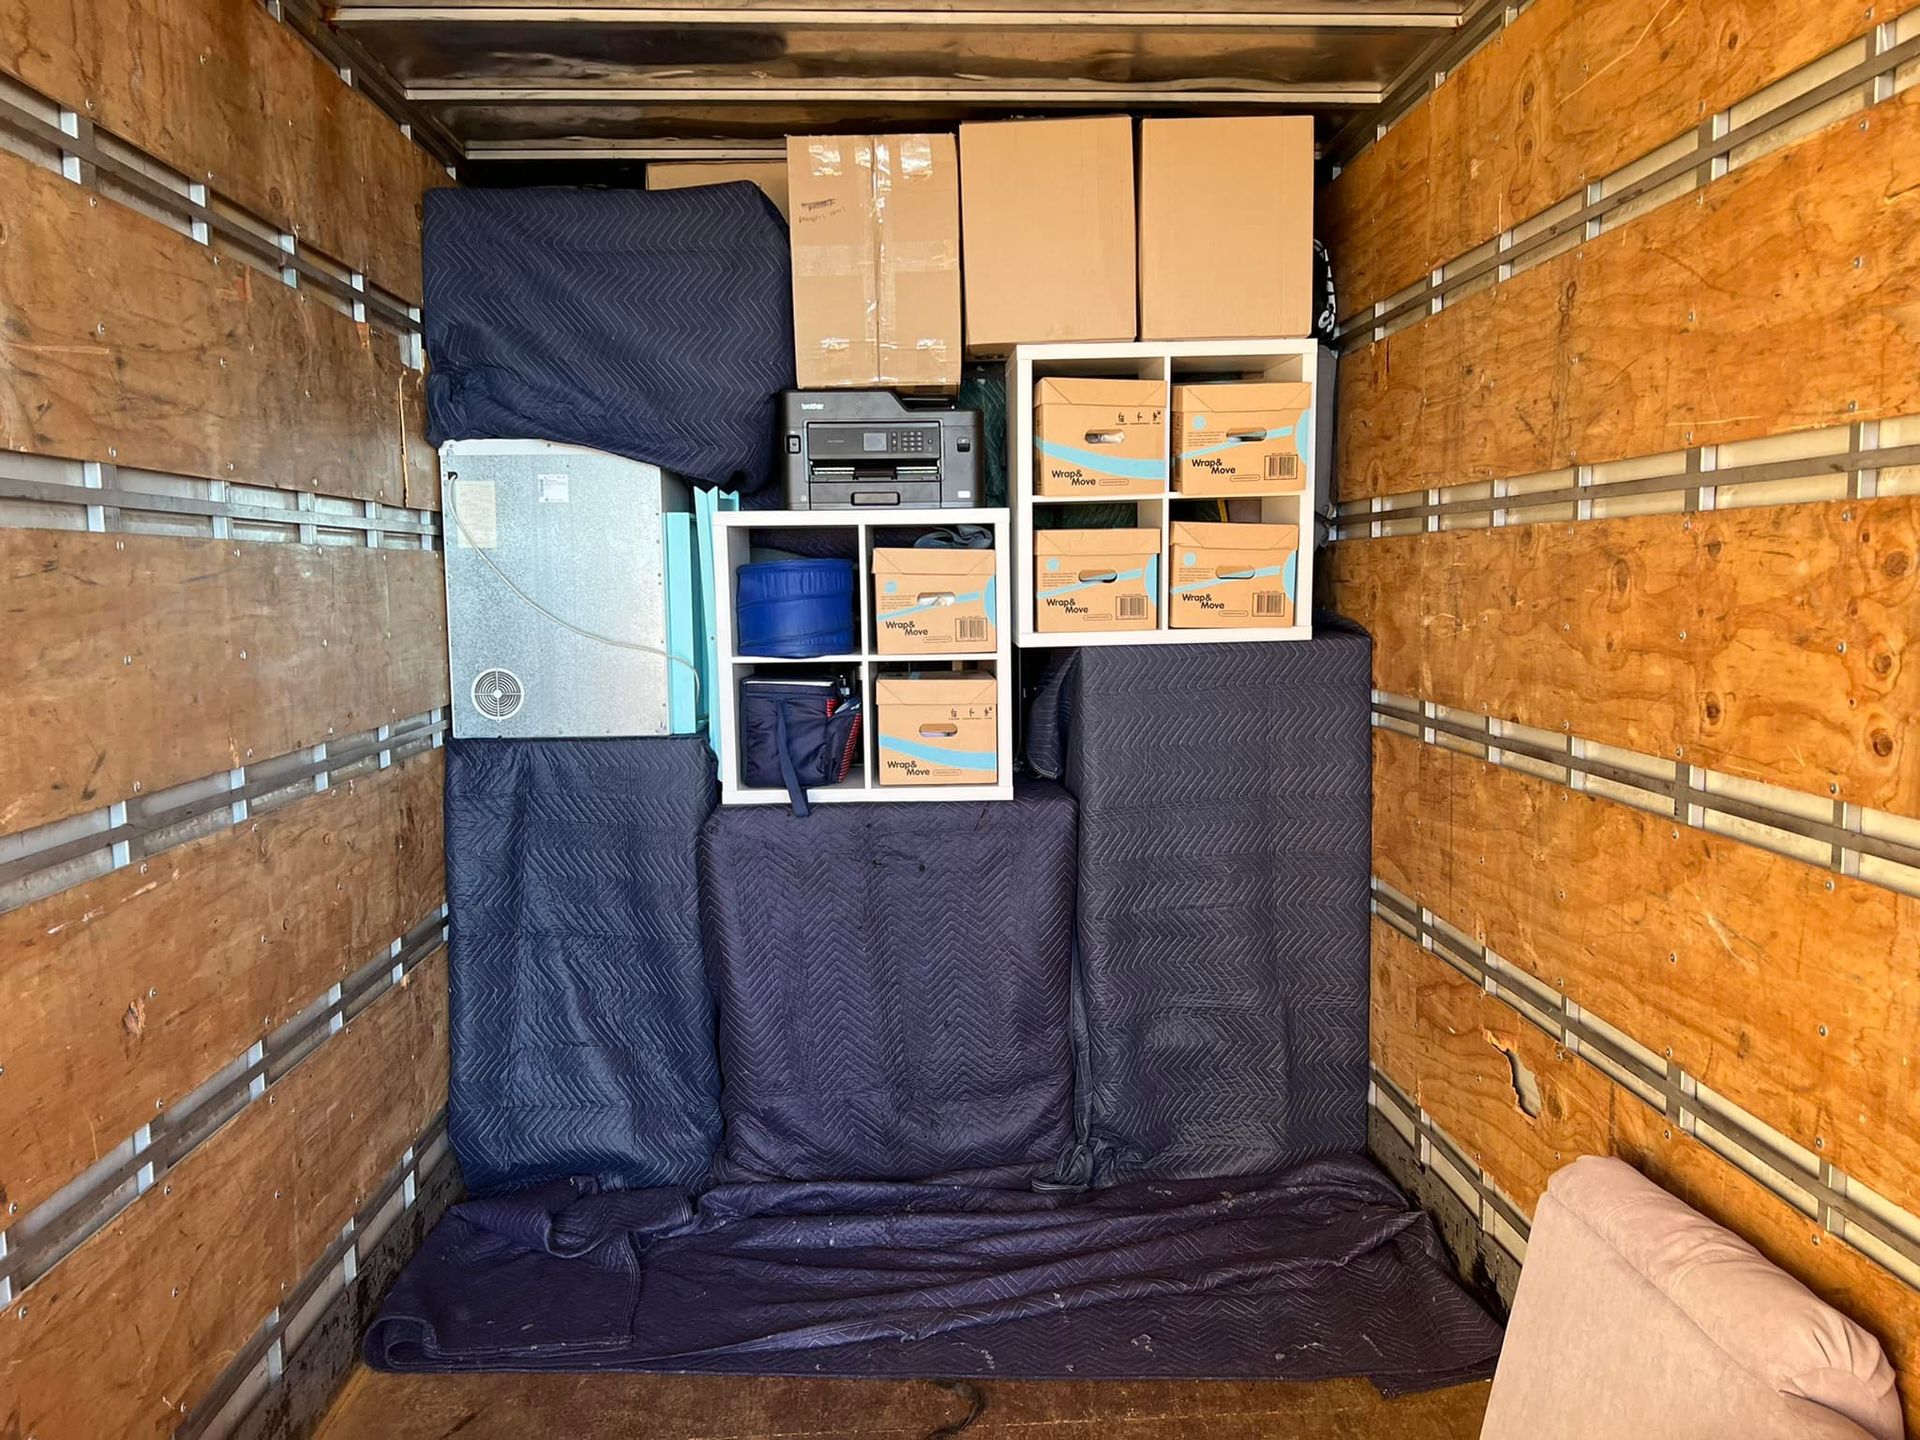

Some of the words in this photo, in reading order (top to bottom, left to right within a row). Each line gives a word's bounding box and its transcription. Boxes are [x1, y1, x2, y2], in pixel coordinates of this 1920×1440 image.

[1191, 458, 1223, 468] Wrap&
[1051, 469, 1083, 479] Wrap&
[1211, 466, 1236, 475] Move
[1071, 477, 1096, 486] Move
[1046, 598, 1076, 608] Wrap&
[1182, 593, 1212, 603] Wrap&
[1065, 605, 1089, 614] Move
[1200, 600, 1225, 610] Move
[885, 620, 916, 631] Wrap&
[904, 627, 929, 636] Move
[886, 760, 917, 770] Wrap&
[906, 767, 931, 776] Move
